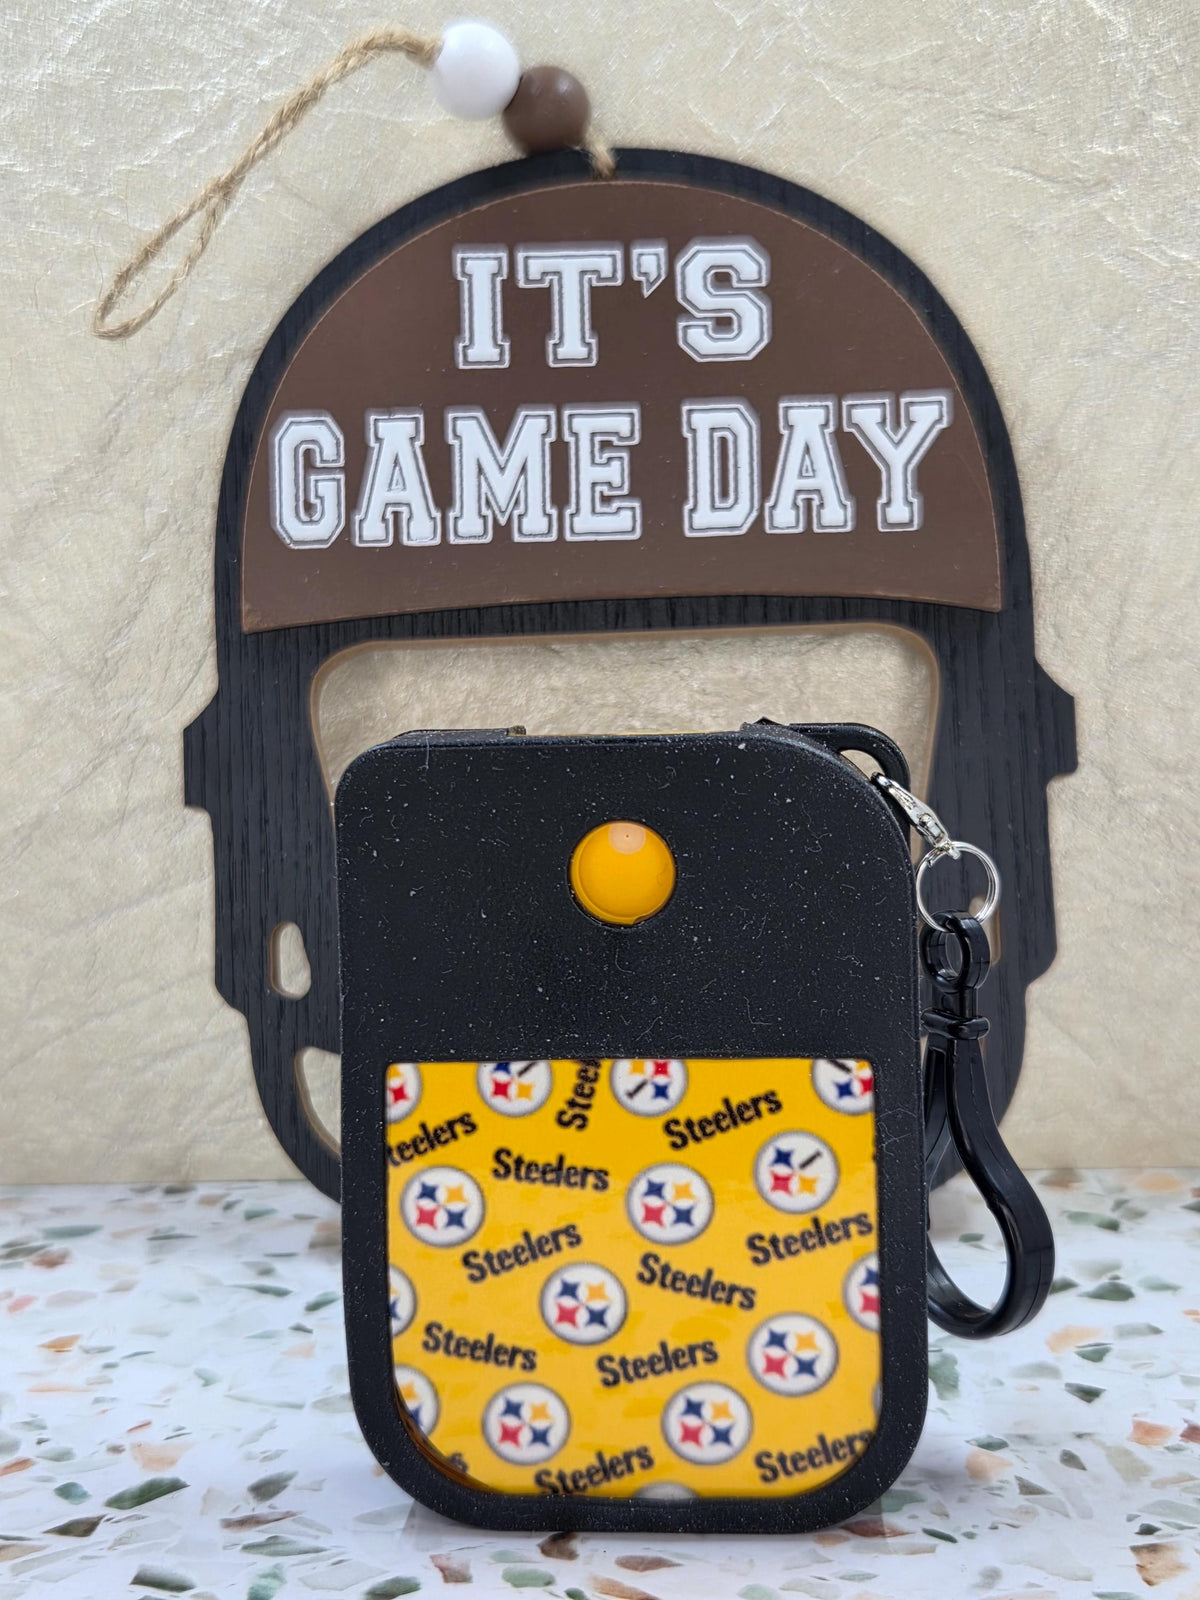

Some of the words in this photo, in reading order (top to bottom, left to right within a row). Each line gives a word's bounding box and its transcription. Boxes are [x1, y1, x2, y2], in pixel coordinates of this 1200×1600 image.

[452, 237, 773, 370] IT'S
[269, 403, 642, 549] GAME
[679, 389, 953, 538] DAY
[663, 1090, 783, 1151] Steelers
[492, 1148, 609, 1191] Steelers
[462, 1223, 582, 1283] Steelers
[746, 1212, 874, 1266] Steelers
[637, 1252, 756, 1310] Steelers
[422, 1321, 538, 1372] Steelers
[596, 1340, 719, 1388] Steelers
[534, 1445, 655, 1494] Steelers
